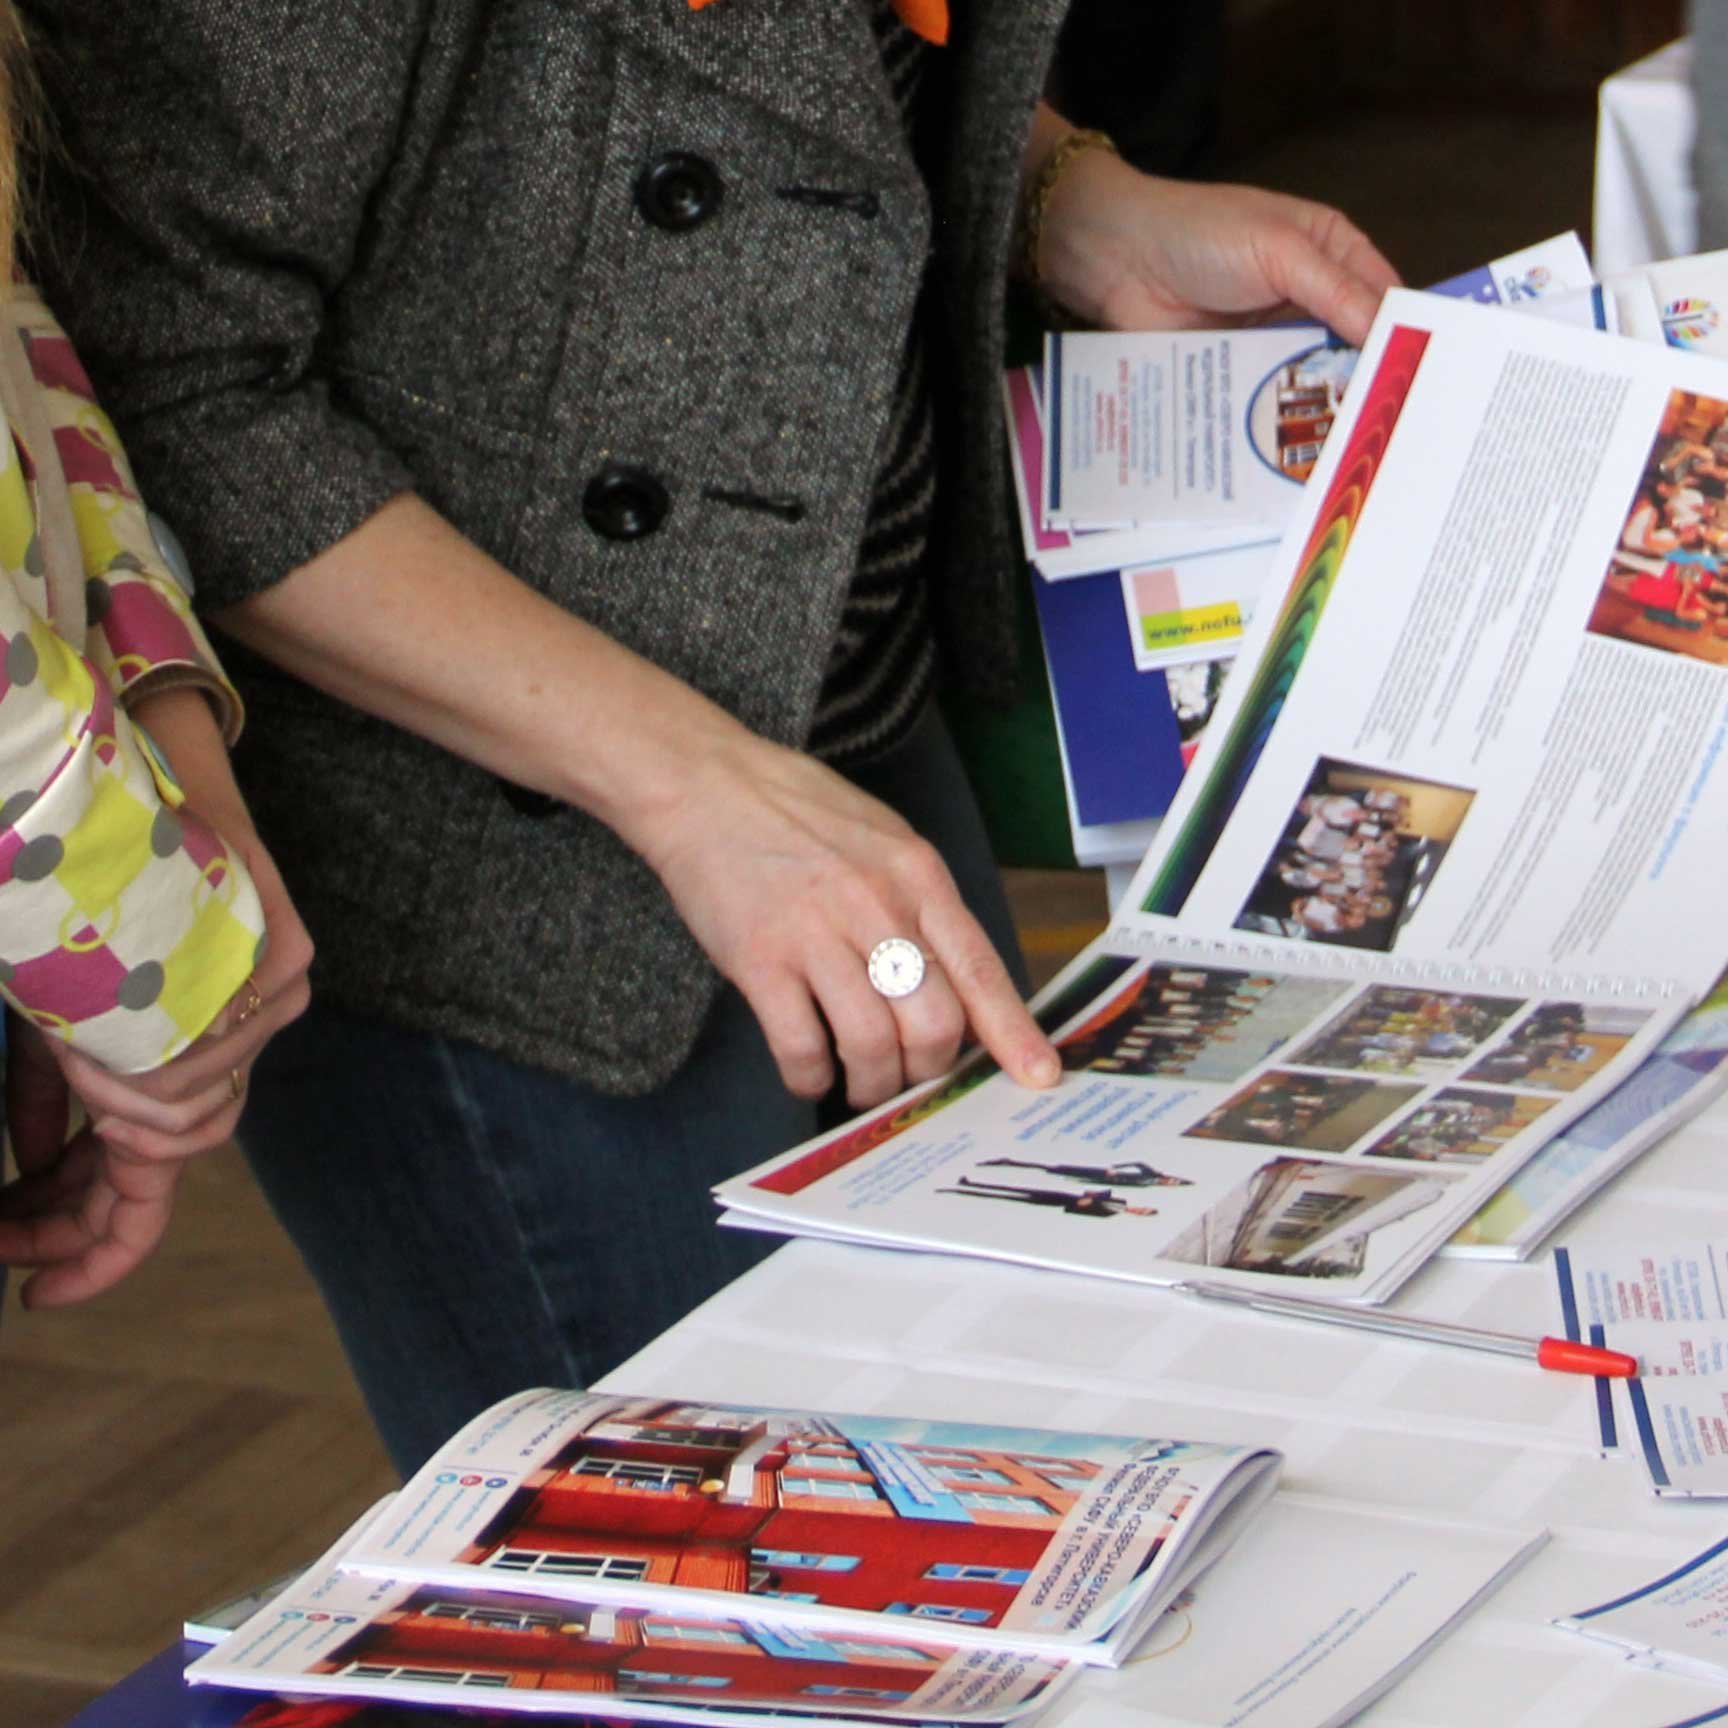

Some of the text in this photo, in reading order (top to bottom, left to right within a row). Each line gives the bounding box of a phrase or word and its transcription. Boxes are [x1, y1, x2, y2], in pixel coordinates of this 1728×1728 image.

[1103, 1464, 1137, 1495] Филиал
[1083, 1496, 1112, 1524] СКФУ
[1106, 1464, 1159, 1529] ФЕДЕРАЛЬНЫЙ
[1137, 1492, 1160, 1511] ВПО
